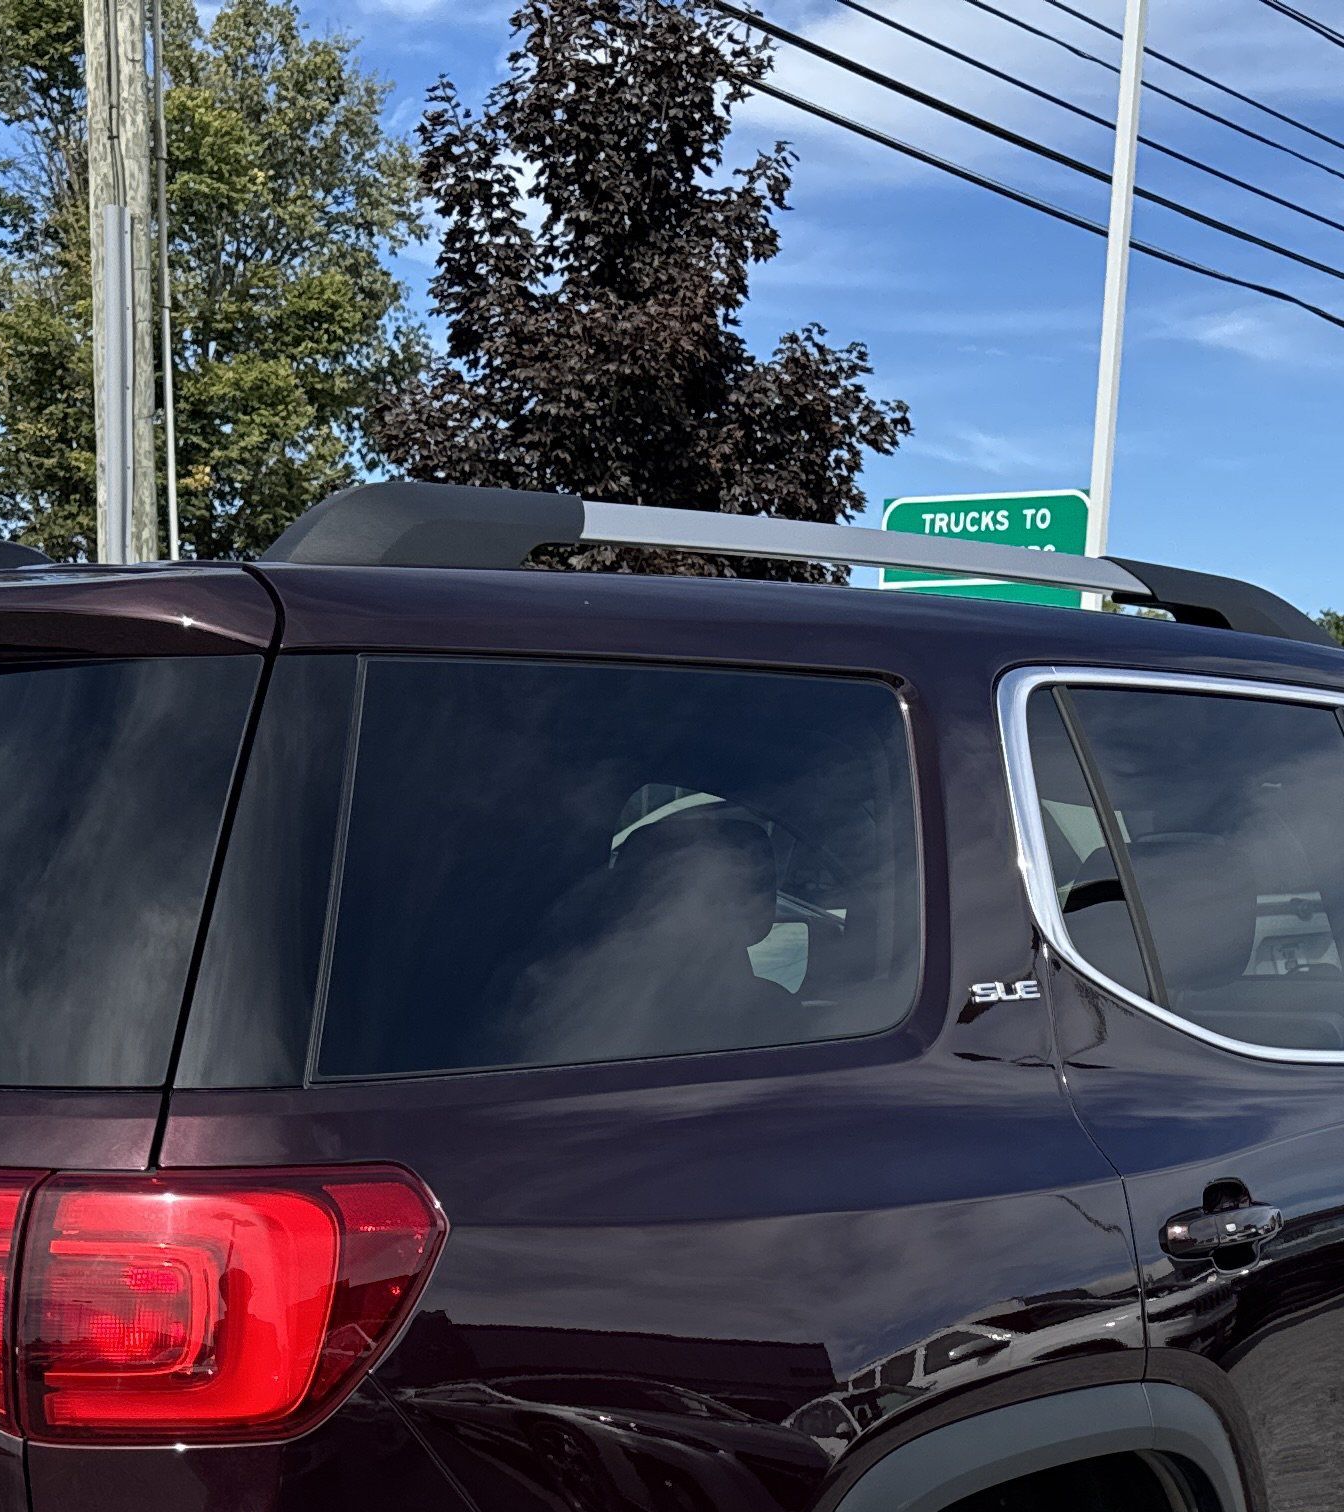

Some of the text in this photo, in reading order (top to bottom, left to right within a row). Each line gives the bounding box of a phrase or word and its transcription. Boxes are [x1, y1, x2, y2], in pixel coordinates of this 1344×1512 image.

[921, 508, 1052, 534] TRUCKS TO
[971, 980, 1041, 1003] SLE
